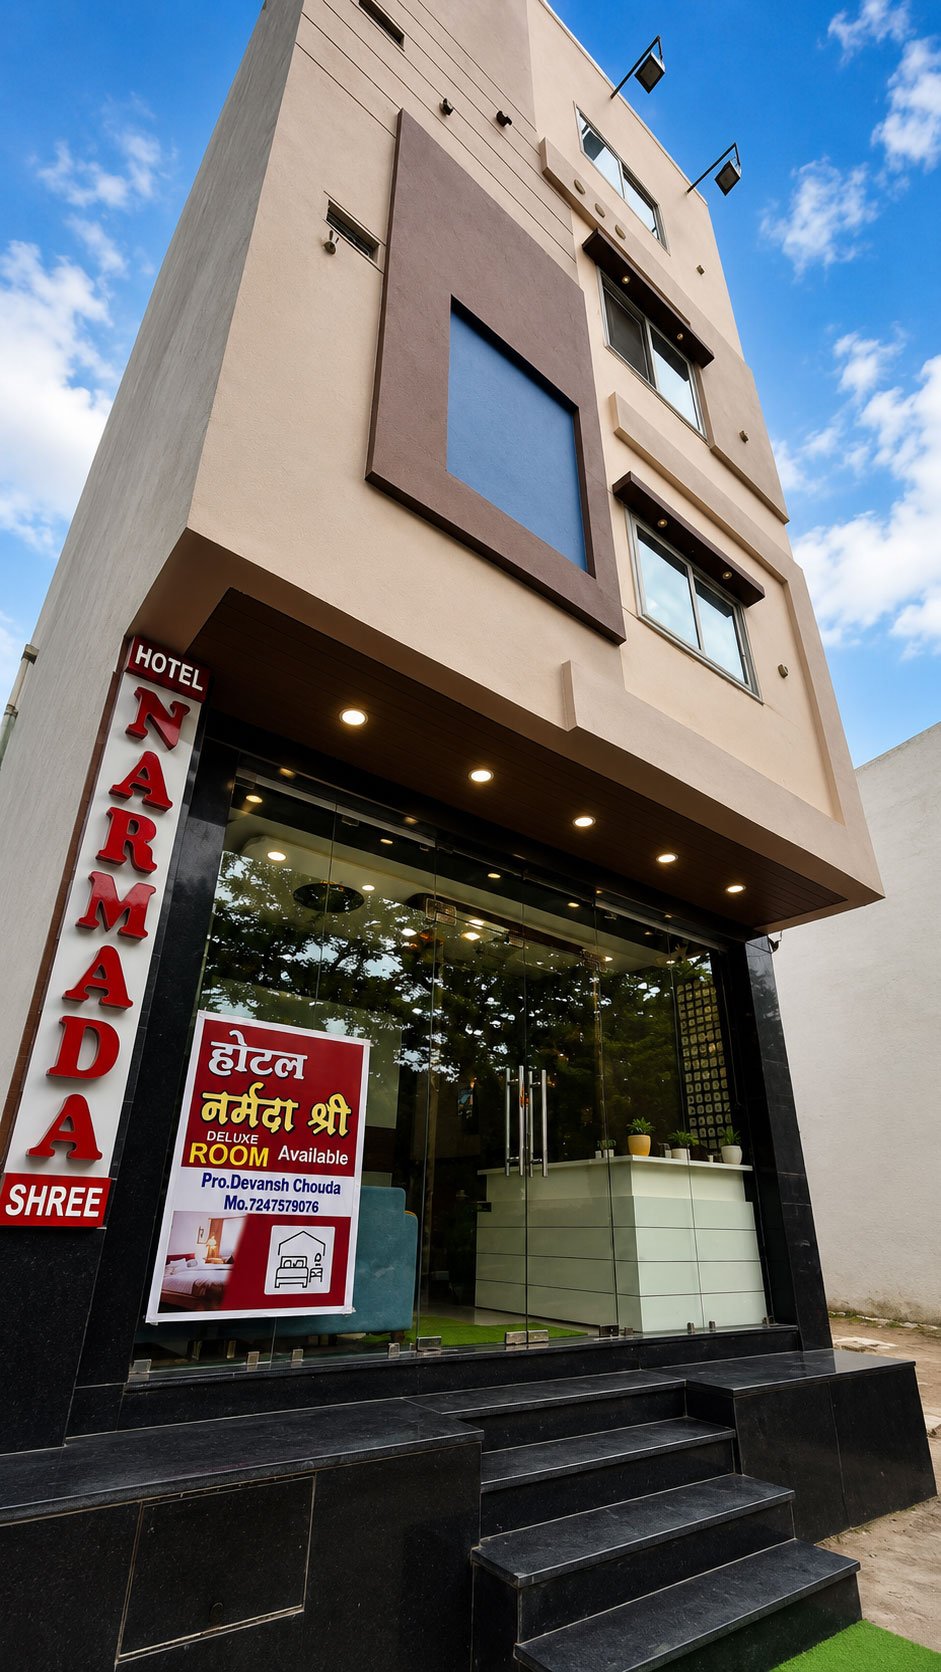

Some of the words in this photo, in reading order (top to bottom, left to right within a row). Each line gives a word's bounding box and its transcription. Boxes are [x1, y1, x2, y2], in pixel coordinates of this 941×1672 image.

[135, 644, 203, 691] HOTEL
[25, 686, 191, 1160] NARMADA
[208, 1029, 308, 1080] होटल
[201, 1081, 299, 1134] नर्मदा
[307, 1093, 352, 1137] श्री
[189, 1142, 269, 1167] ROOM
[277, 1145, 349, 1165] Available
[206, 1130, 259, 1144] DELUXE
[5, 1184, 103, 1217] SHREE
[201, 1172, 289, 1192] Pro.Devansh
[293, 1178, 341, 1195] Chouda
